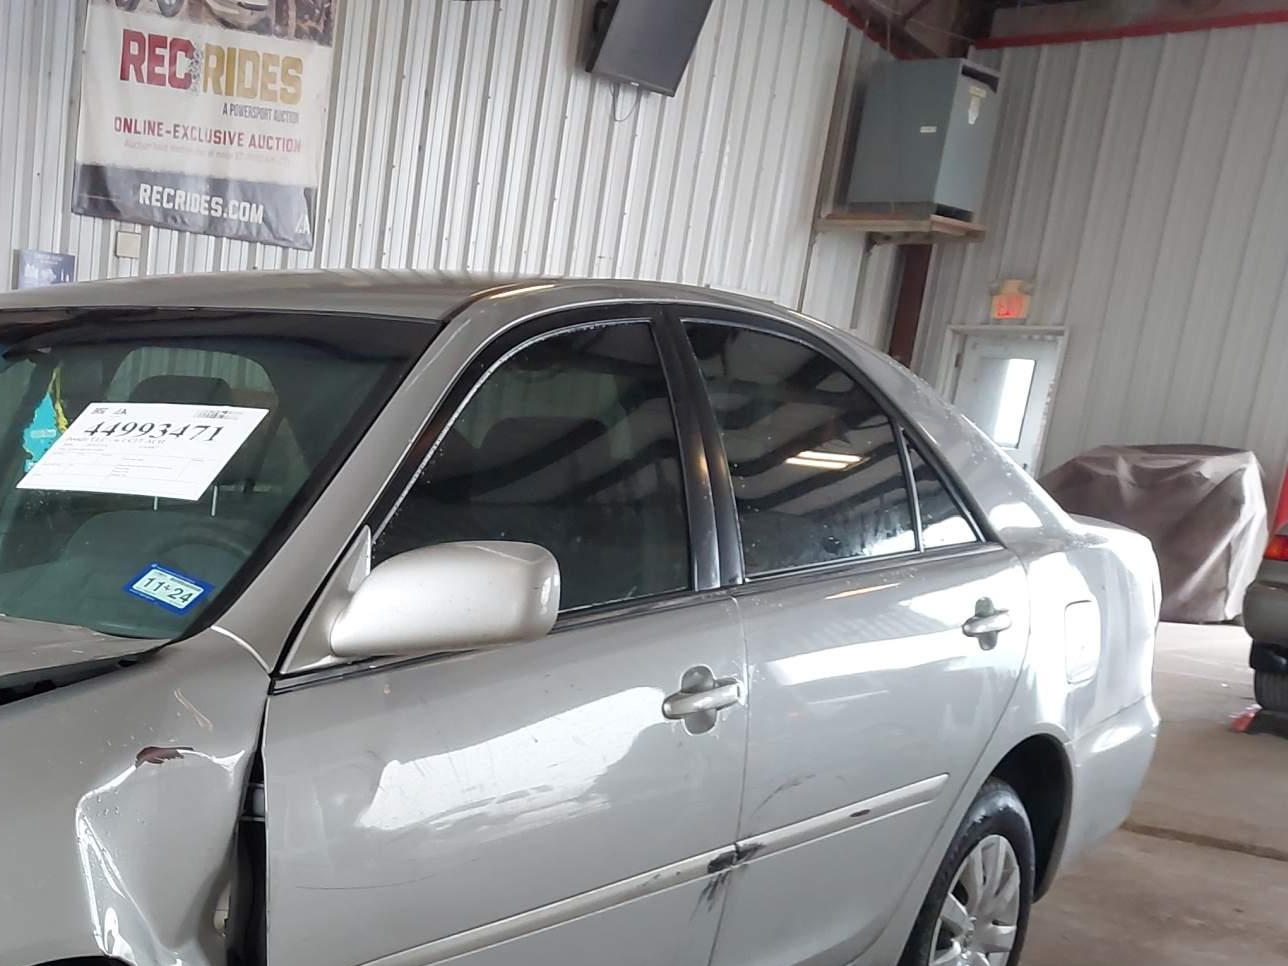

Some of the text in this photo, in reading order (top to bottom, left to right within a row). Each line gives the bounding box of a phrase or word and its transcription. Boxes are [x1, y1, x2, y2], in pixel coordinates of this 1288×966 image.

[120, 29, 303, 105] REC RIDES
[222, 102, 228, 116] A
[114, 116, 245, 147] ONLINE-EXCLUSIVE
[248, 133, 301, 153] AUCTION
[139, 183, 263, 224] RECRIDES.COM
[85, 421, 224, 442] 44993471
